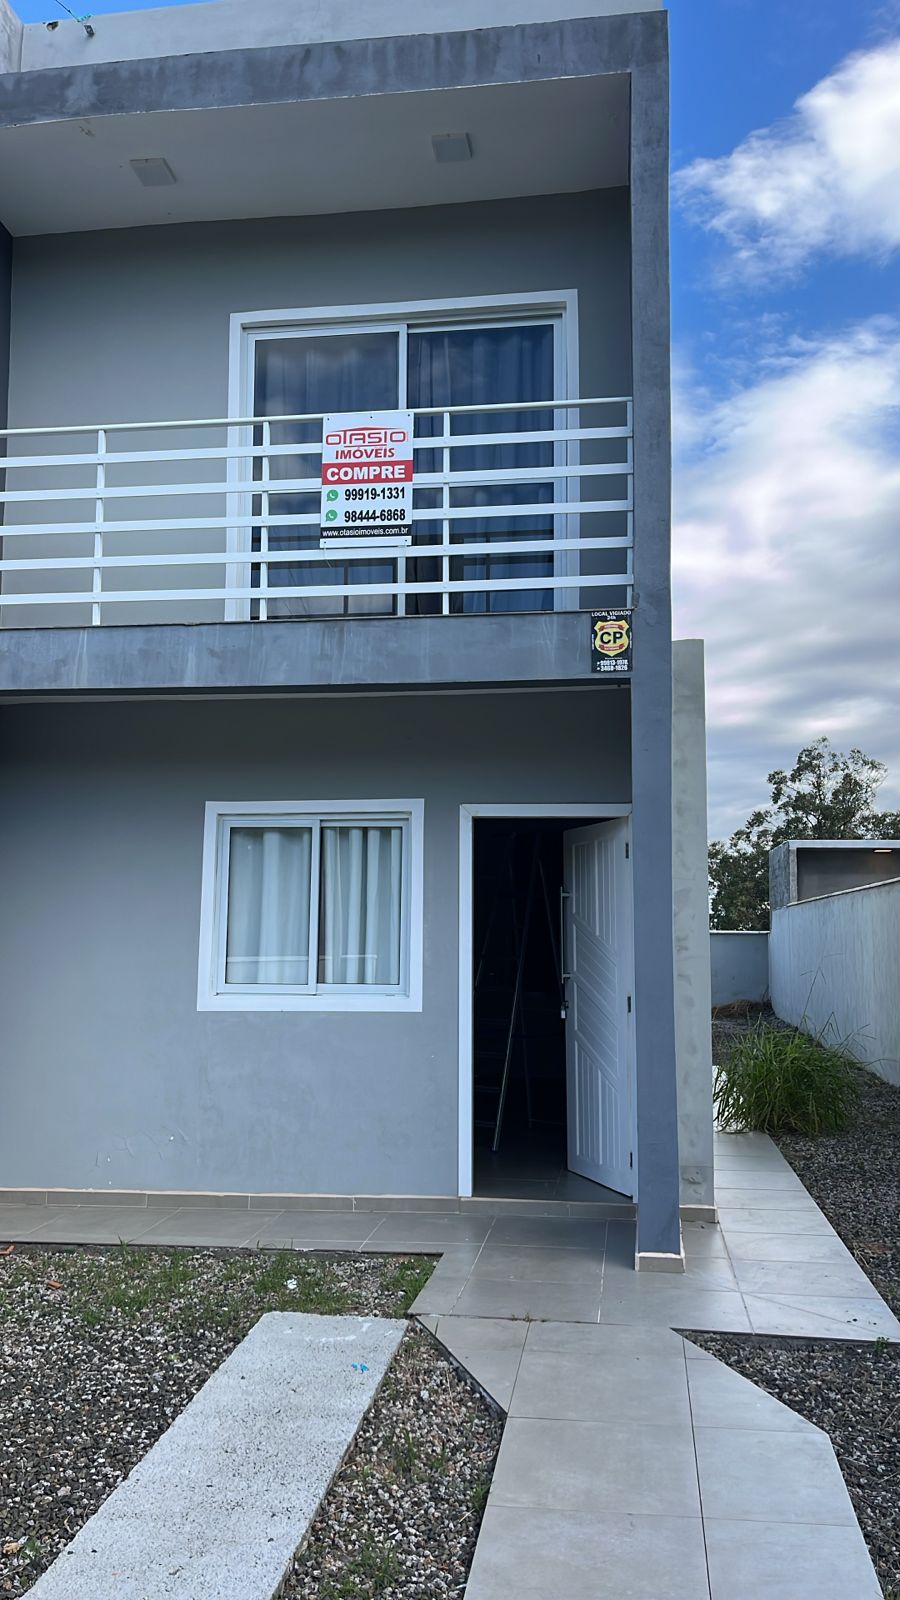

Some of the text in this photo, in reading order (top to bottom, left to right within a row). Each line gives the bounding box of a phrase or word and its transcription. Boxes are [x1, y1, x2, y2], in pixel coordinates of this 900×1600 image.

[335, 447, 395, 460] IMÓVEIS
[326, 465, 406, 481] COMPRE
[344, 486, 406, 501] 99919-1331
[344, 508, 406, 523] 98444-6868
[322, 526, 409, 537] www.otasioimoveis.com.br
[600, 631, 623, 644] CP
